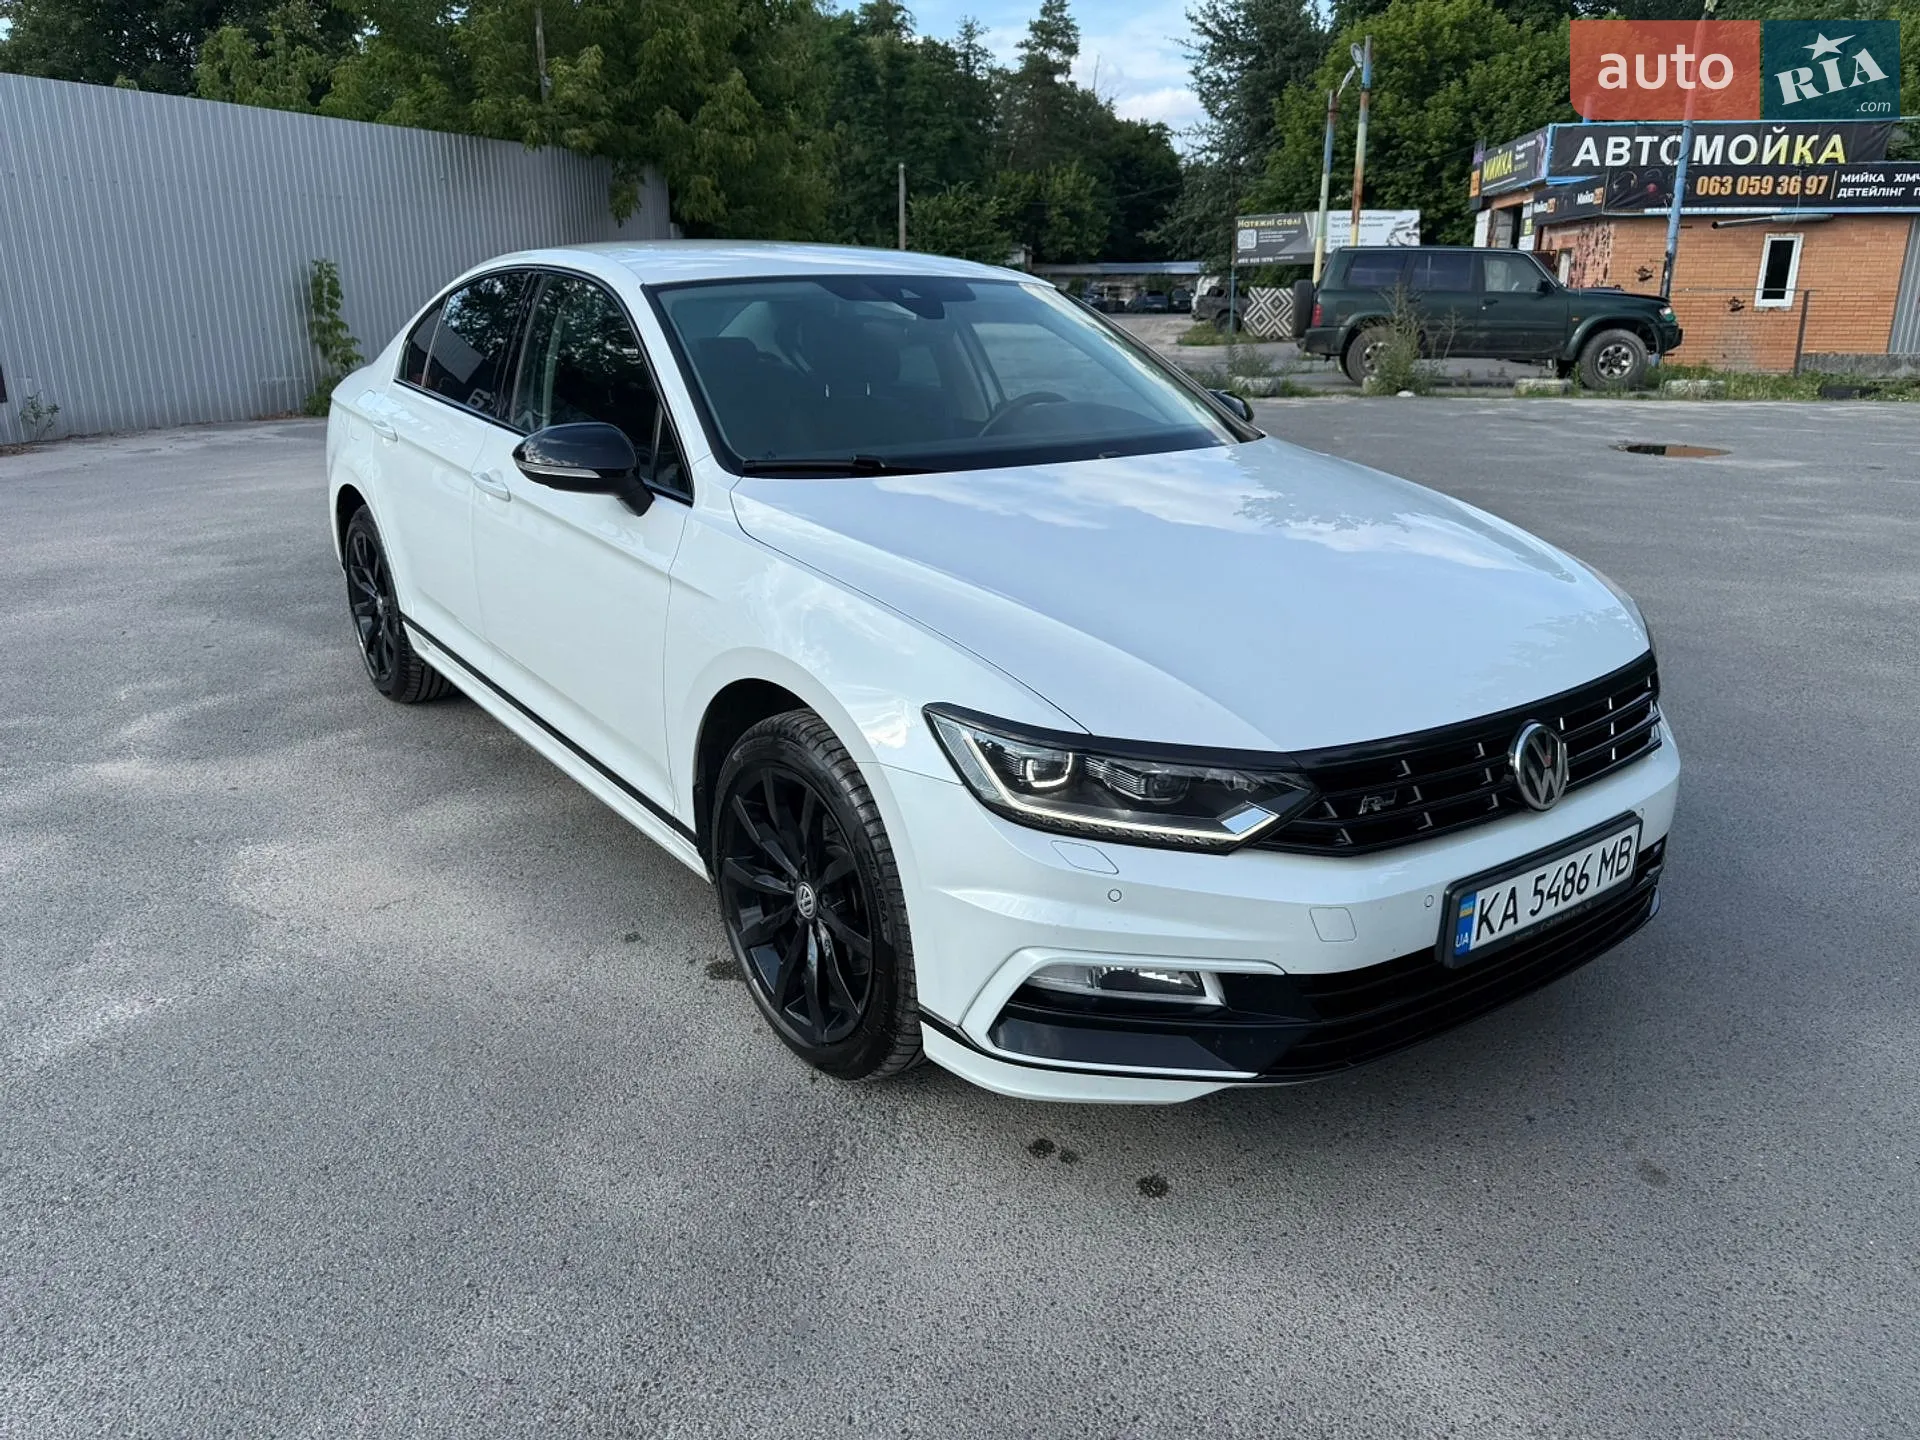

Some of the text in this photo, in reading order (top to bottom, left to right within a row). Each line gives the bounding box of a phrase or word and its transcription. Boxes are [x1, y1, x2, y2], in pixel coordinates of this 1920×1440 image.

[1572, 126, 1846, 167] АВТОМОЙКА
[1696, 175, 1829, 196] 063 059 36 97
[1840, 172, 1885, 183] МИЙКА
[1837, 186, 1906, 198] ДЕТЕЙЛІНГ
[1475, 886, 1519, 942] KA
[1529, 853, 1593, 917] 5486
[1596, 835, 1633, 888] MB
[1455, 932, 1469, 948] UA
